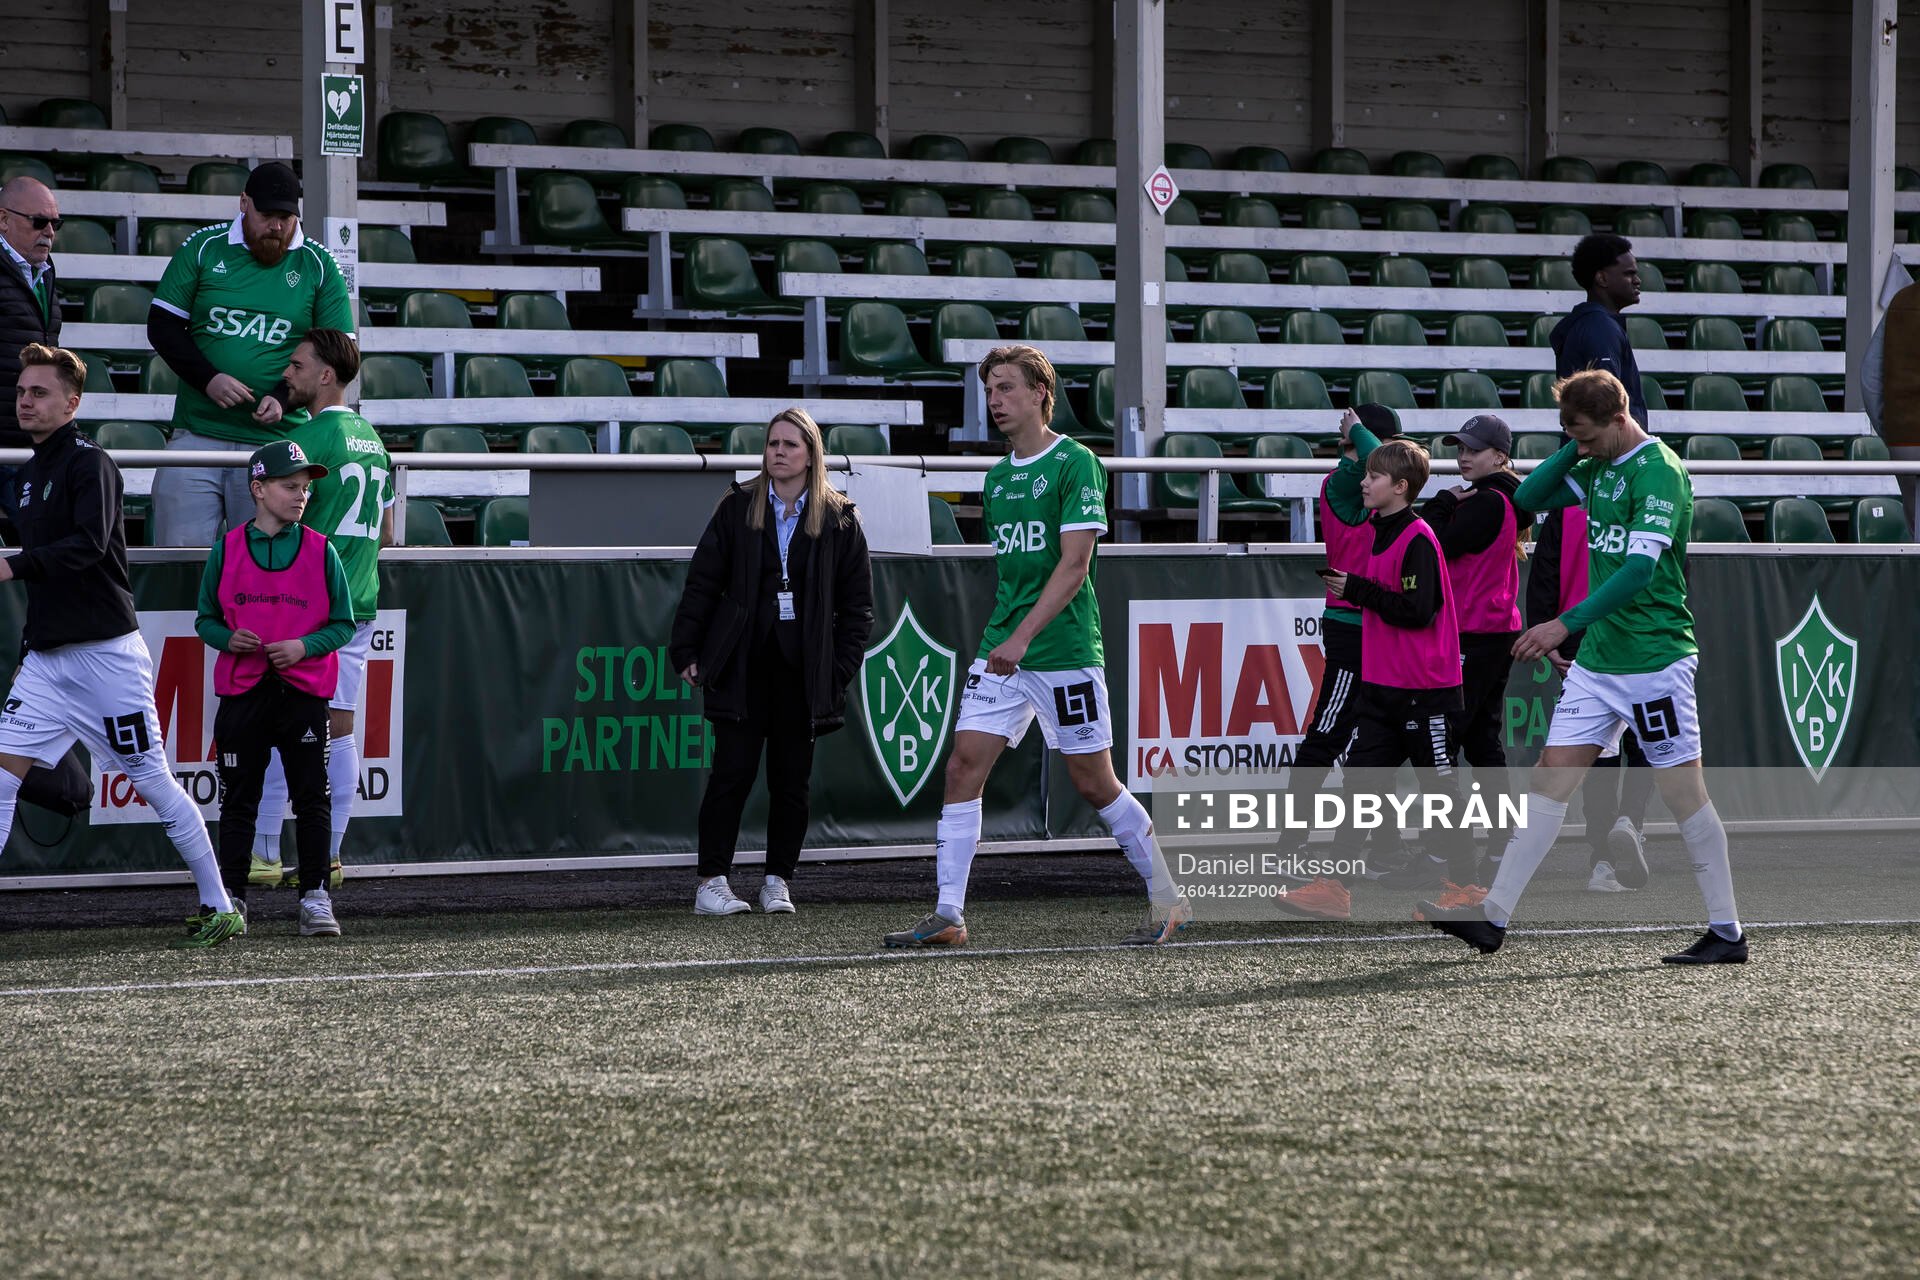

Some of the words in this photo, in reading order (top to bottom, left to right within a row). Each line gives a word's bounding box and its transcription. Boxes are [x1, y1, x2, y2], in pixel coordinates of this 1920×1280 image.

[335, 3, 355, 53] E
[206, 306, 292, 345] SSAB
[335, 462, 390, 540] 23
[994, 520, 1047, 555] SAB
[972, 692, 997, 704] Energi
[9, 717, 36, 730] Energi
[1137, 746, 1178, 778] ICA
